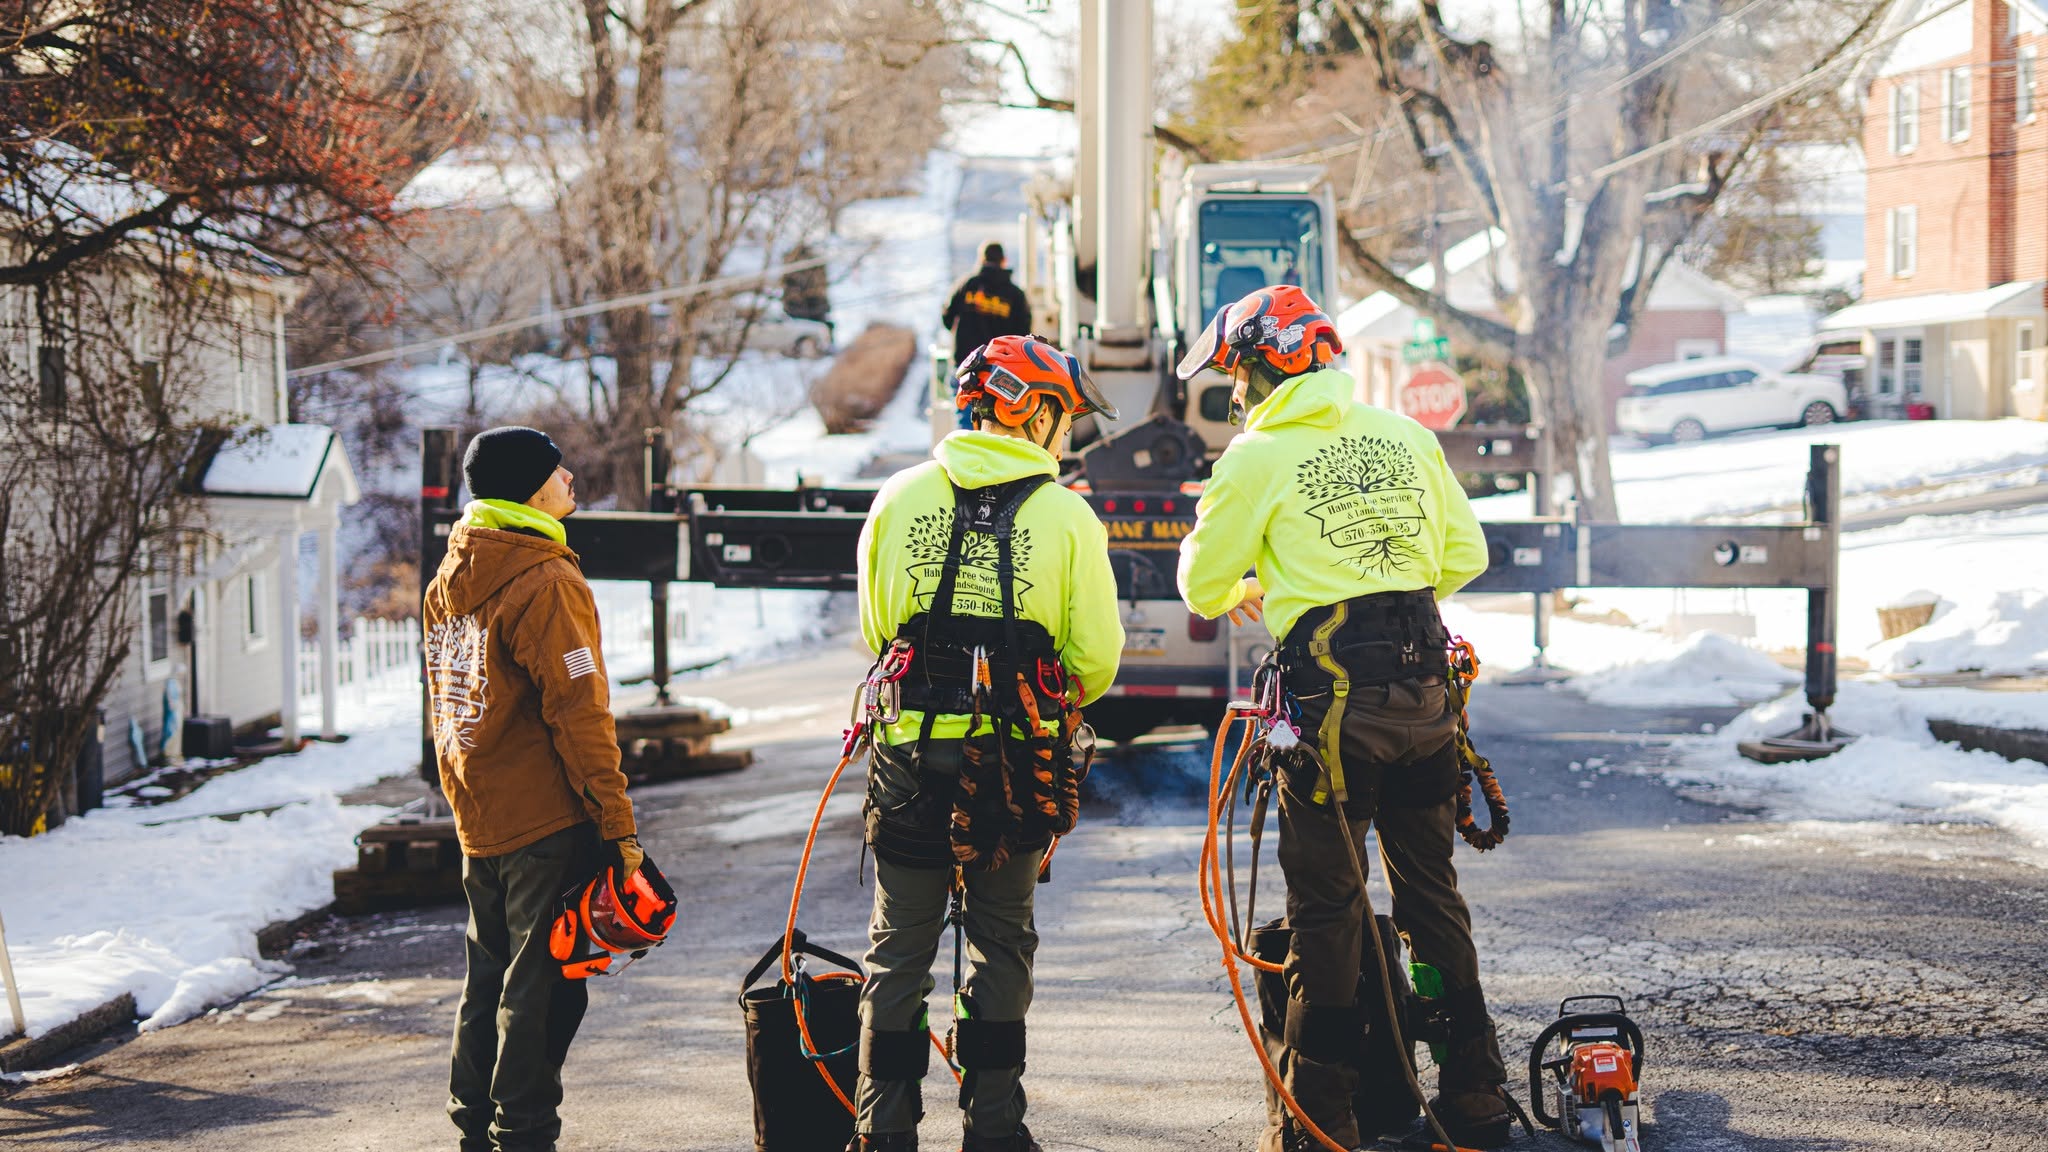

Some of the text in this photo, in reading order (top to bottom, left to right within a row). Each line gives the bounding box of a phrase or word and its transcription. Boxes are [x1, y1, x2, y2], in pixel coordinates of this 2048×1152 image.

[1402, 383, 1459, 415] STOP
[1380, 493, 1412, 505] Service
[1347, 512, 1354, 520] &
[957, 569, 977, 581] Tree
